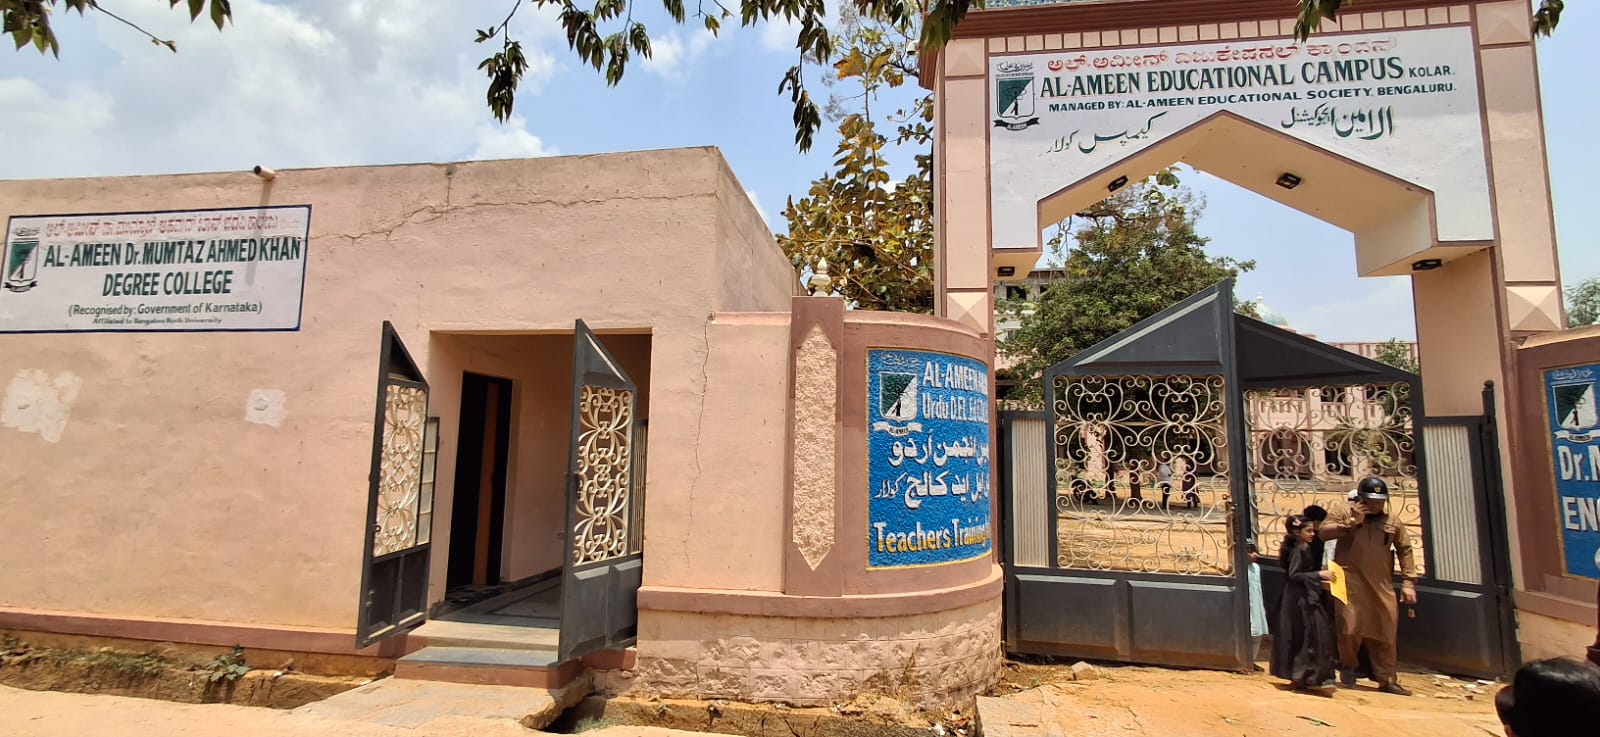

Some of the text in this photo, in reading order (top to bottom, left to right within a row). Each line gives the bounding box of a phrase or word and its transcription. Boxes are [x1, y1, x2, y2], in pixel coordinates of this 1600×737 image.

[1040, 72, 1140, 98] AL-AMEEN
[1147, 62, 1295, 92] EDUCATIONAL
[1301, 56, 1404, 84] CAMPUS
[1049, 100, 1105, 112] MANAGED
[1126, 96, 1194, 108] AL-AMEEN
[1198, 91, 1302, 105] EDUCATIONAL
[43, 242, 121, 268] AL-AMEEN
[206, 238, 256, 263] AHMED
[258, 236, 301, 261] KHAN
[102, 270, 234, 297] DEGREE COLLEGE
[137, 303, 192, 315] Government
[192, 302, 204, 314] of
[205, 301, 263, 315] Karnataka)
[184, 316, 222, 325] University
[922, 392, 949, 419] Urdu
[1561, 495, 1600, 531] EN
[873, 520, 952, 554] Teachers
